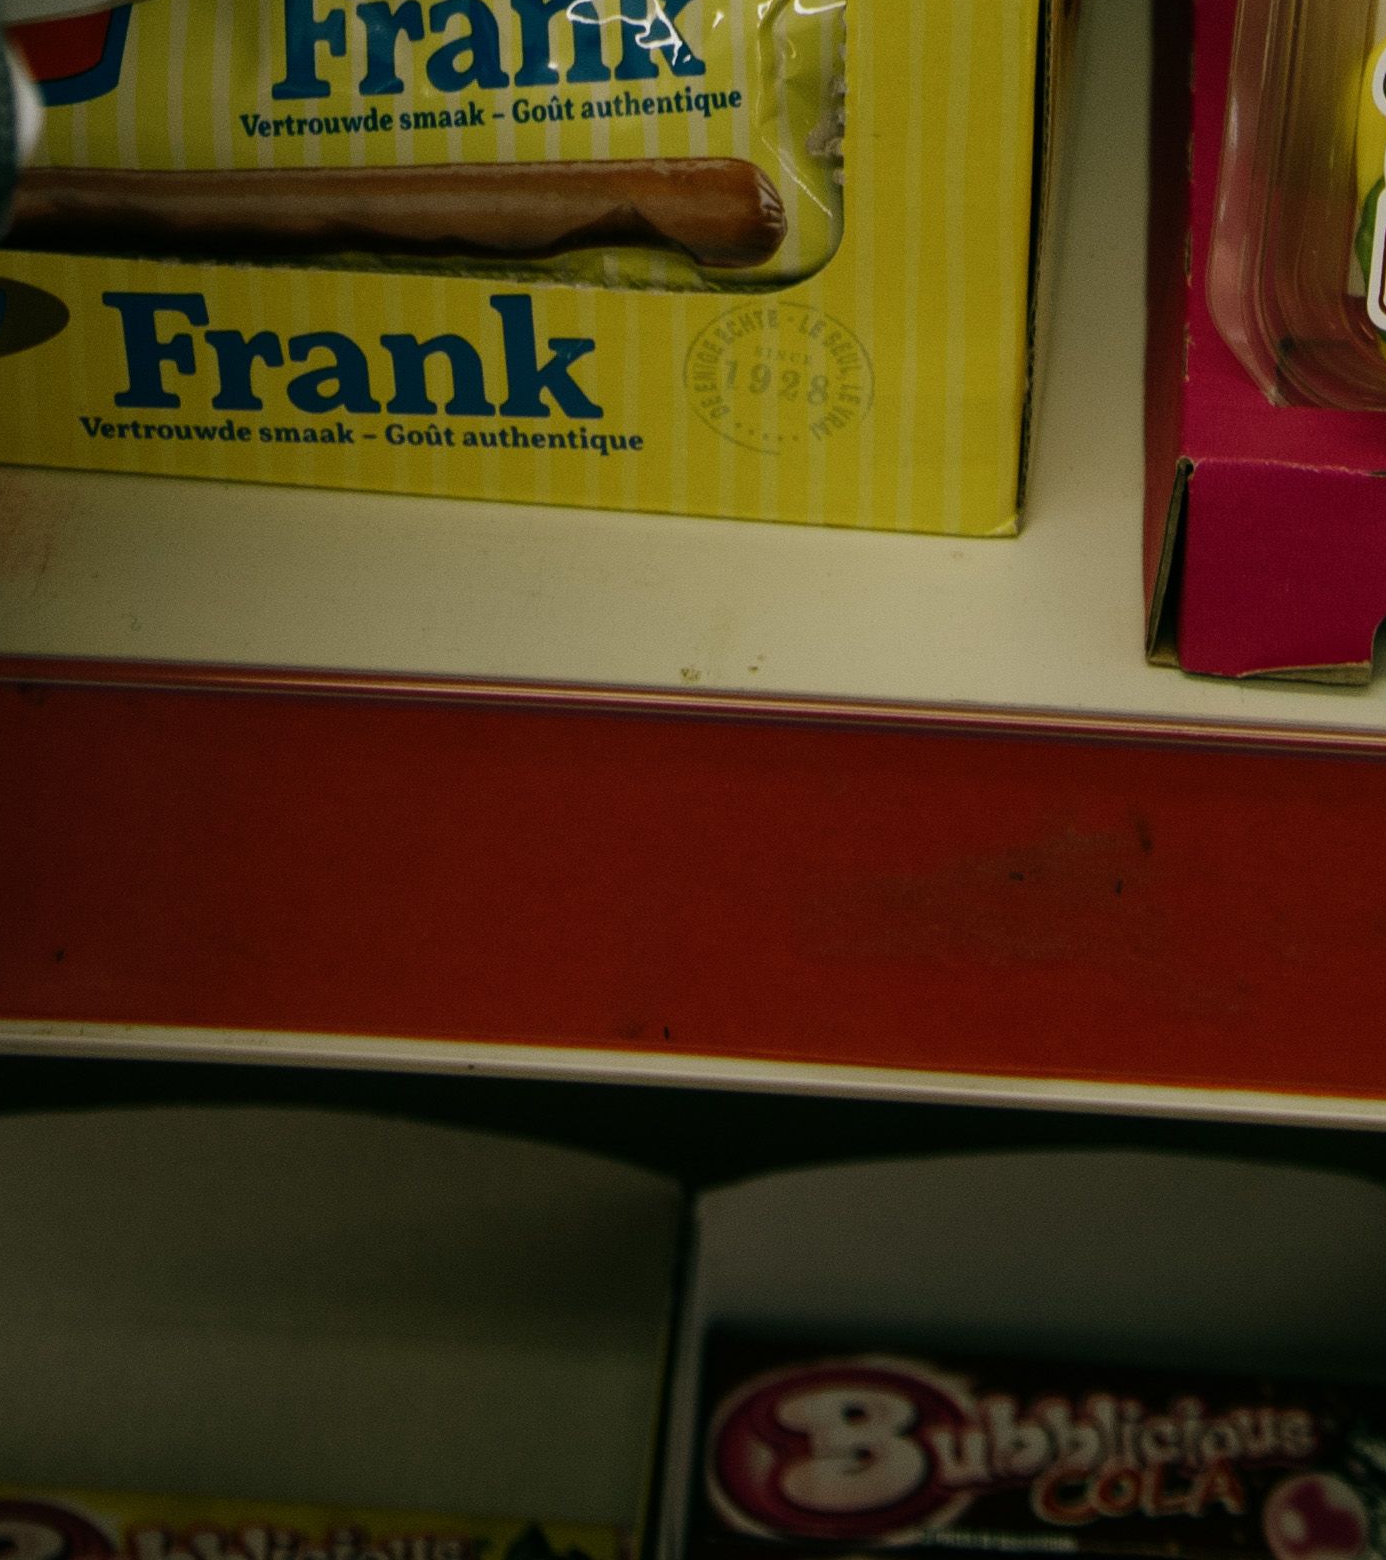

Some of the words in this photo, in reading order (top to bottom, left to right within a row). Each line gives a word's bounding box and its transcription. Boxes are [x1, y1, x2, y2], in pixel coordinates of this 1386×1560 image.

[240, 109, 395, 138] Vertrouwde
[400, 104, 485, 131] smaak
[512, 95, 575, 124] Goût
[580, 86, 744, 123] authentique
[103, 290, 604, 420] Frank
[725, 358, 830, 406] 1928
[80, 414, 253, 444] Vertrouwde
[259, 419, 355, 445] smaak
[385, 421, 456, 449] Goût
[462, 427, 644, 458] authentique
[775, 1388, 1319, 1513] Bubblicious
[1036, 1460, 1245, 1521] COLA
